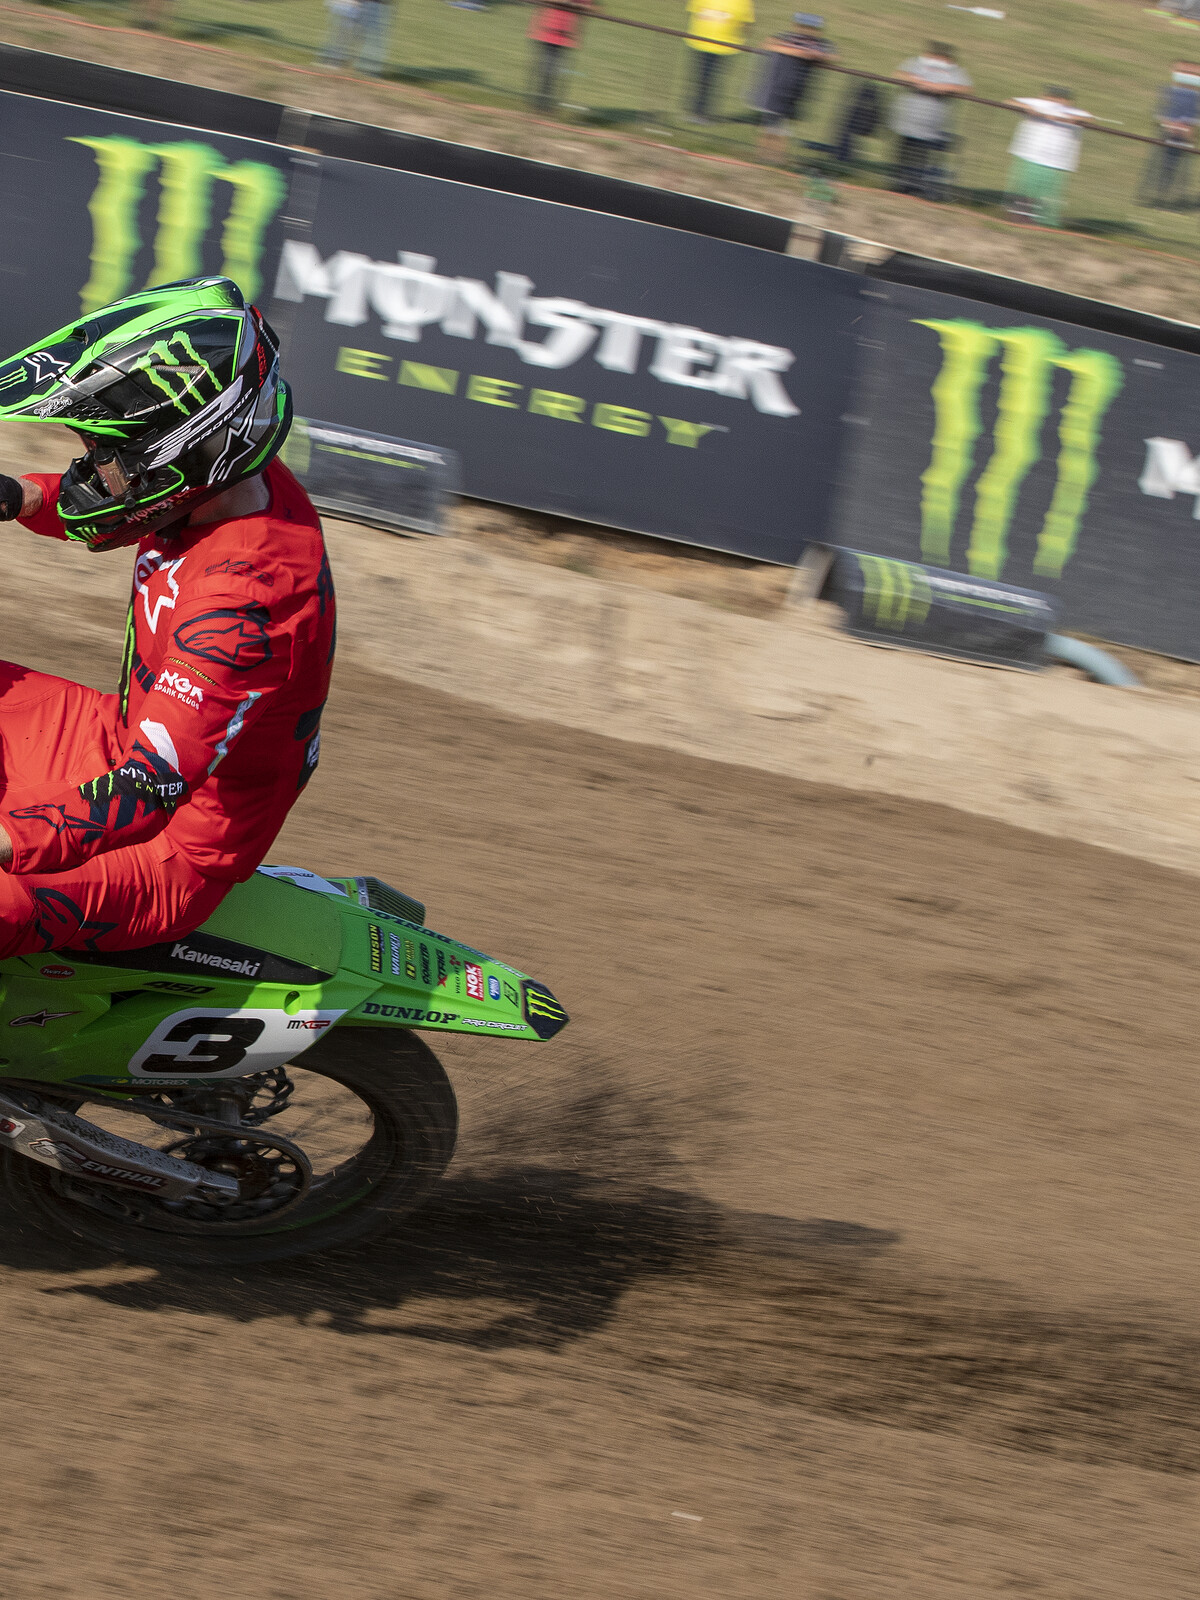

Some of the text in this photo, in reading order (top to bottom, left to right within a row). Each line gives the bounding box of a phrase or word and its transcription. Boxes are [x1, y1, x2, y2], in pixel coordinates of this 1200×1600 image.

[273, 239, 800, 418] MONSTER
[336, 346, 712, 448] ENERGY
[154, 683, 200, 710] SPARK PLUGS
[158, 668, 204, 702] NGK
[171, 943, 260, 977] Kawasaki
[369, 924, 380, 972] HINSON
[466, 963, 479, 997] NGK
[287, 1020, 331, 1029] MXGP
[362, 1002, 458, 1025] DUNLOP
[462, 1018, 528, 1031] PRO CIRCUIT
[141, 1016, 266, 1074] 3
[131, 1078, 190, 1086] MOTOREX
